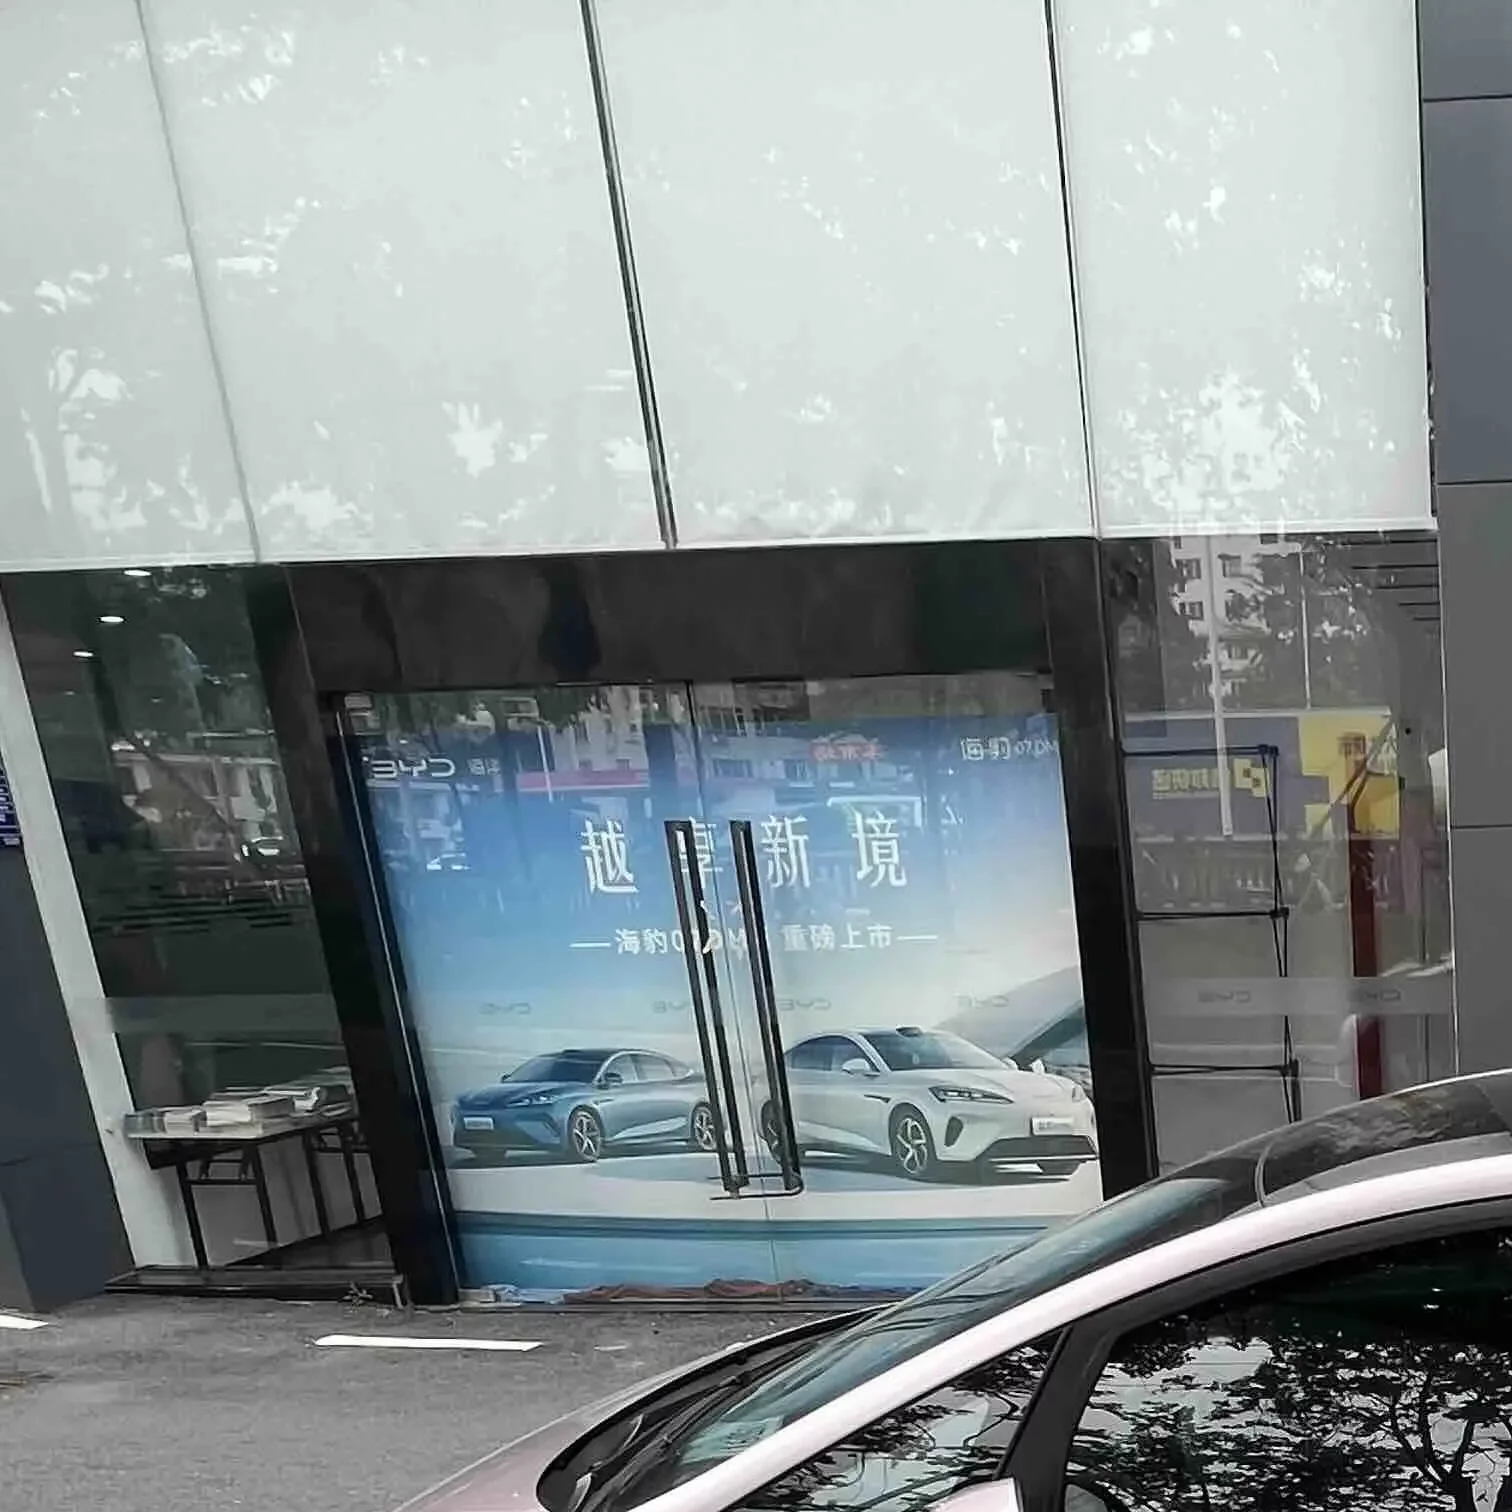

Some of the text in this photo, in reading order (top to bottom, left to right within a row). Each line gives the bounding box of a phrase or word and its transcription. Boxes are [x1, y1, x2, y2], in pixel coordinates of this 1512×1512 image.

[371, 757, 456, 779] BYD
[782, 922, 894, 953] 重磅上市
[777, 998, 832, 1012] BYD
